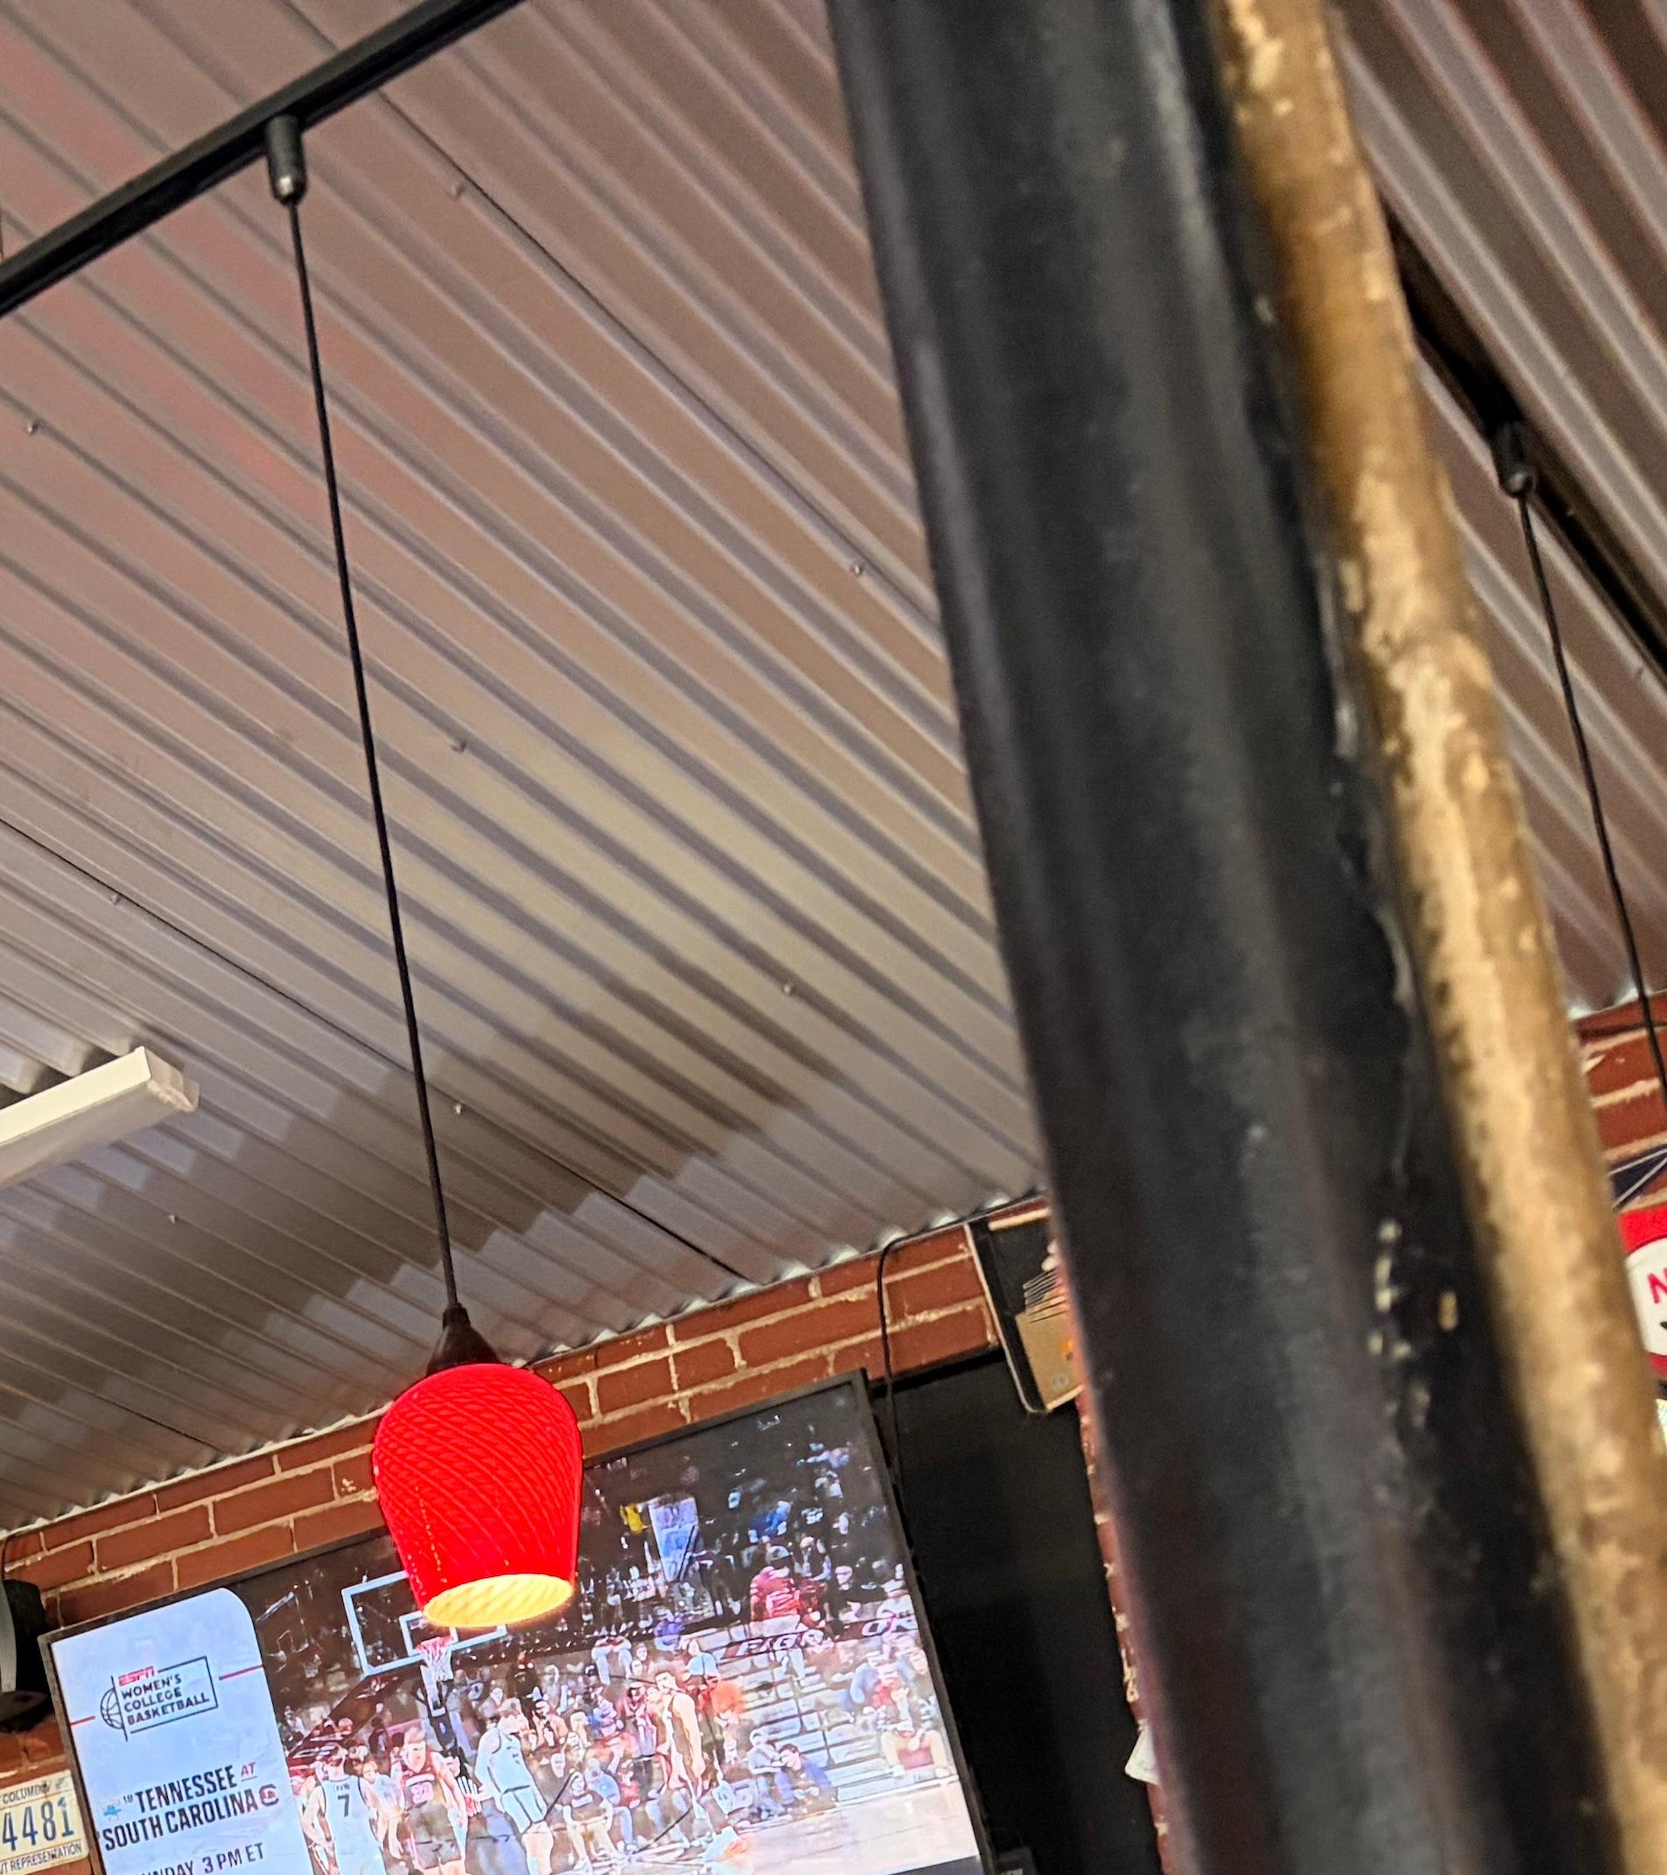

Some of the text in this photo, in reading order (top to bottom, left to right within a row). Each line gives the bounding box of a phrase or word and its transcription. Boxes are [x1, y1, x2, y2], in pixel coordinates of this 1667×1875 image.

[121, 1674, 183, 1701] WOMEN'S
[123, 1688, 184, 1714] COLLEGE
[126, 1692, 210, 1726] BASKETBALL
[134, 1771, 237, 1815] TENNESSEE
[0, 1796, 76, 1853] 4481
[103, 1788, 259, 1853] SOUTH CAROLINA
[11, 1841, 84, 1875] REPRESENTATION
[216, 1851, 241, 1872] PM
[243, 1844, 265, 1865] ET
